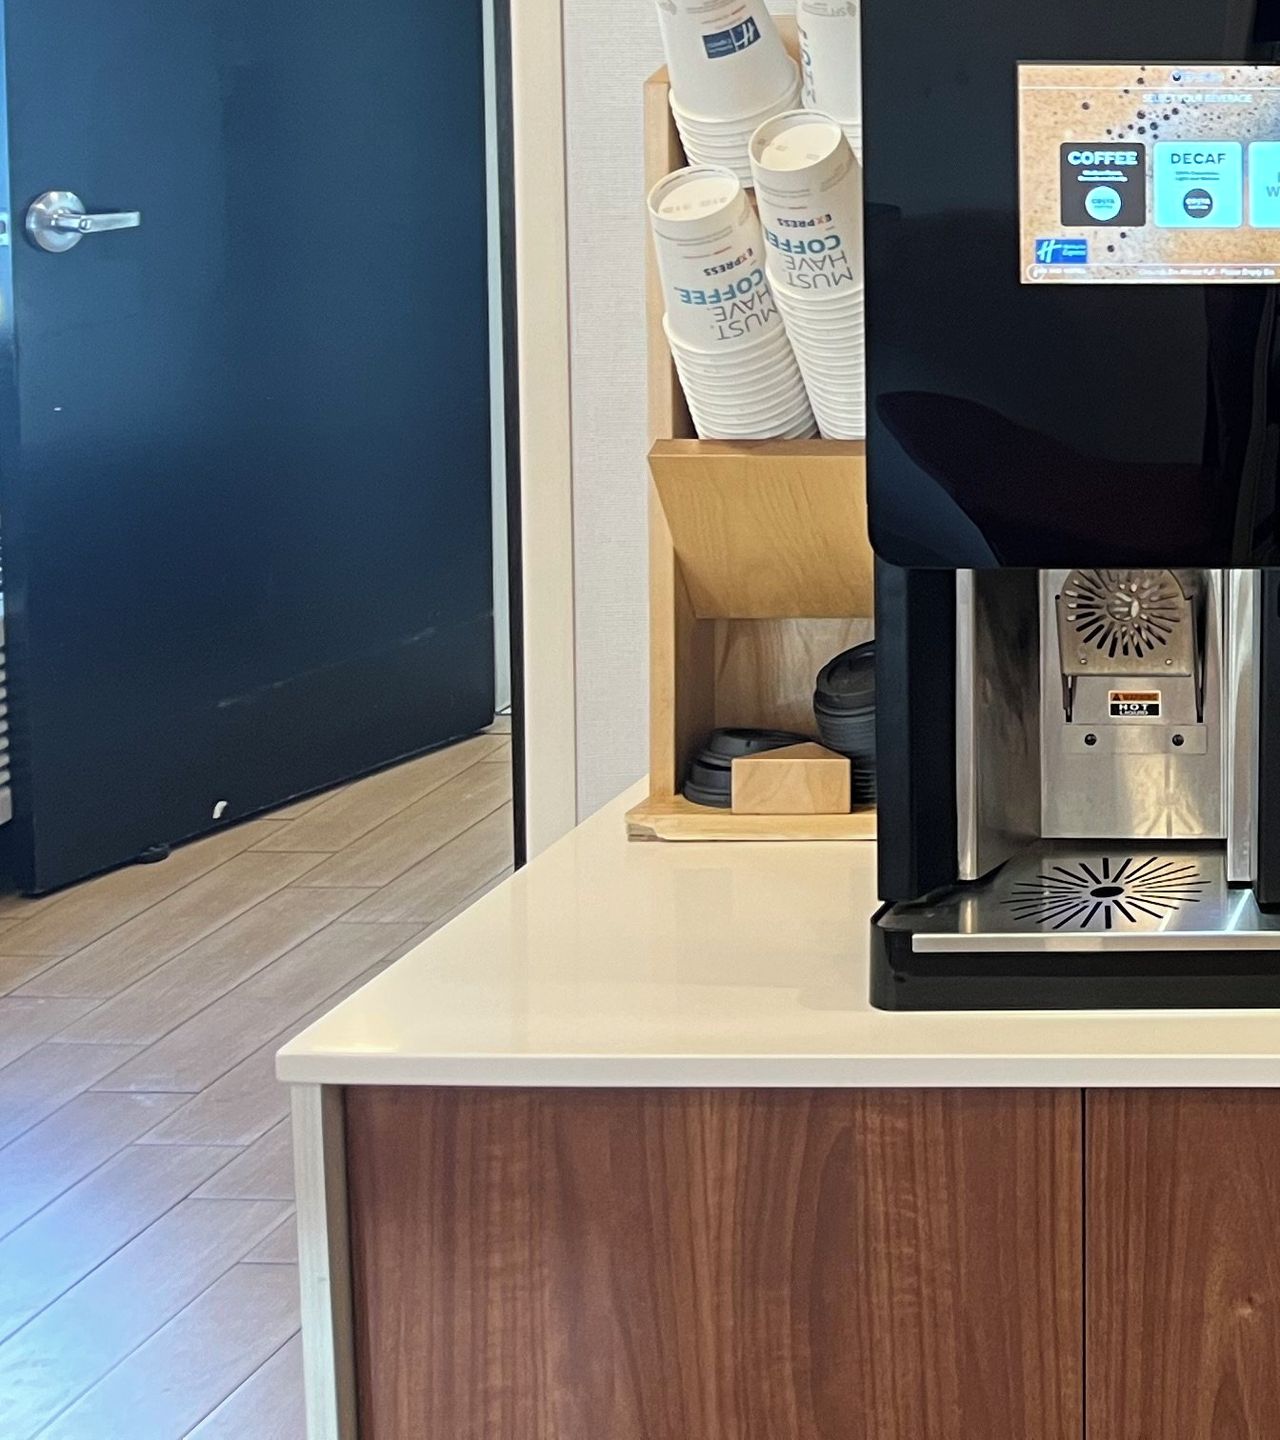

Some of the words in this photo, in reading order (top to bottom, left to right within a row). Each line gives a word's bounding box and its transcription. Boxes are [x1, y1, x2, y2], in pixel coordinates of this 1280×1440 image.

[1067, 151, 1138, 166] COFFEE
[1170, 152, 1227, 165] DECAF
[776, 213, 833, 229] EXPRESS
[703, 247, 754, 277] EXPRESS
[1119, 703, 1148, 711] HOT
